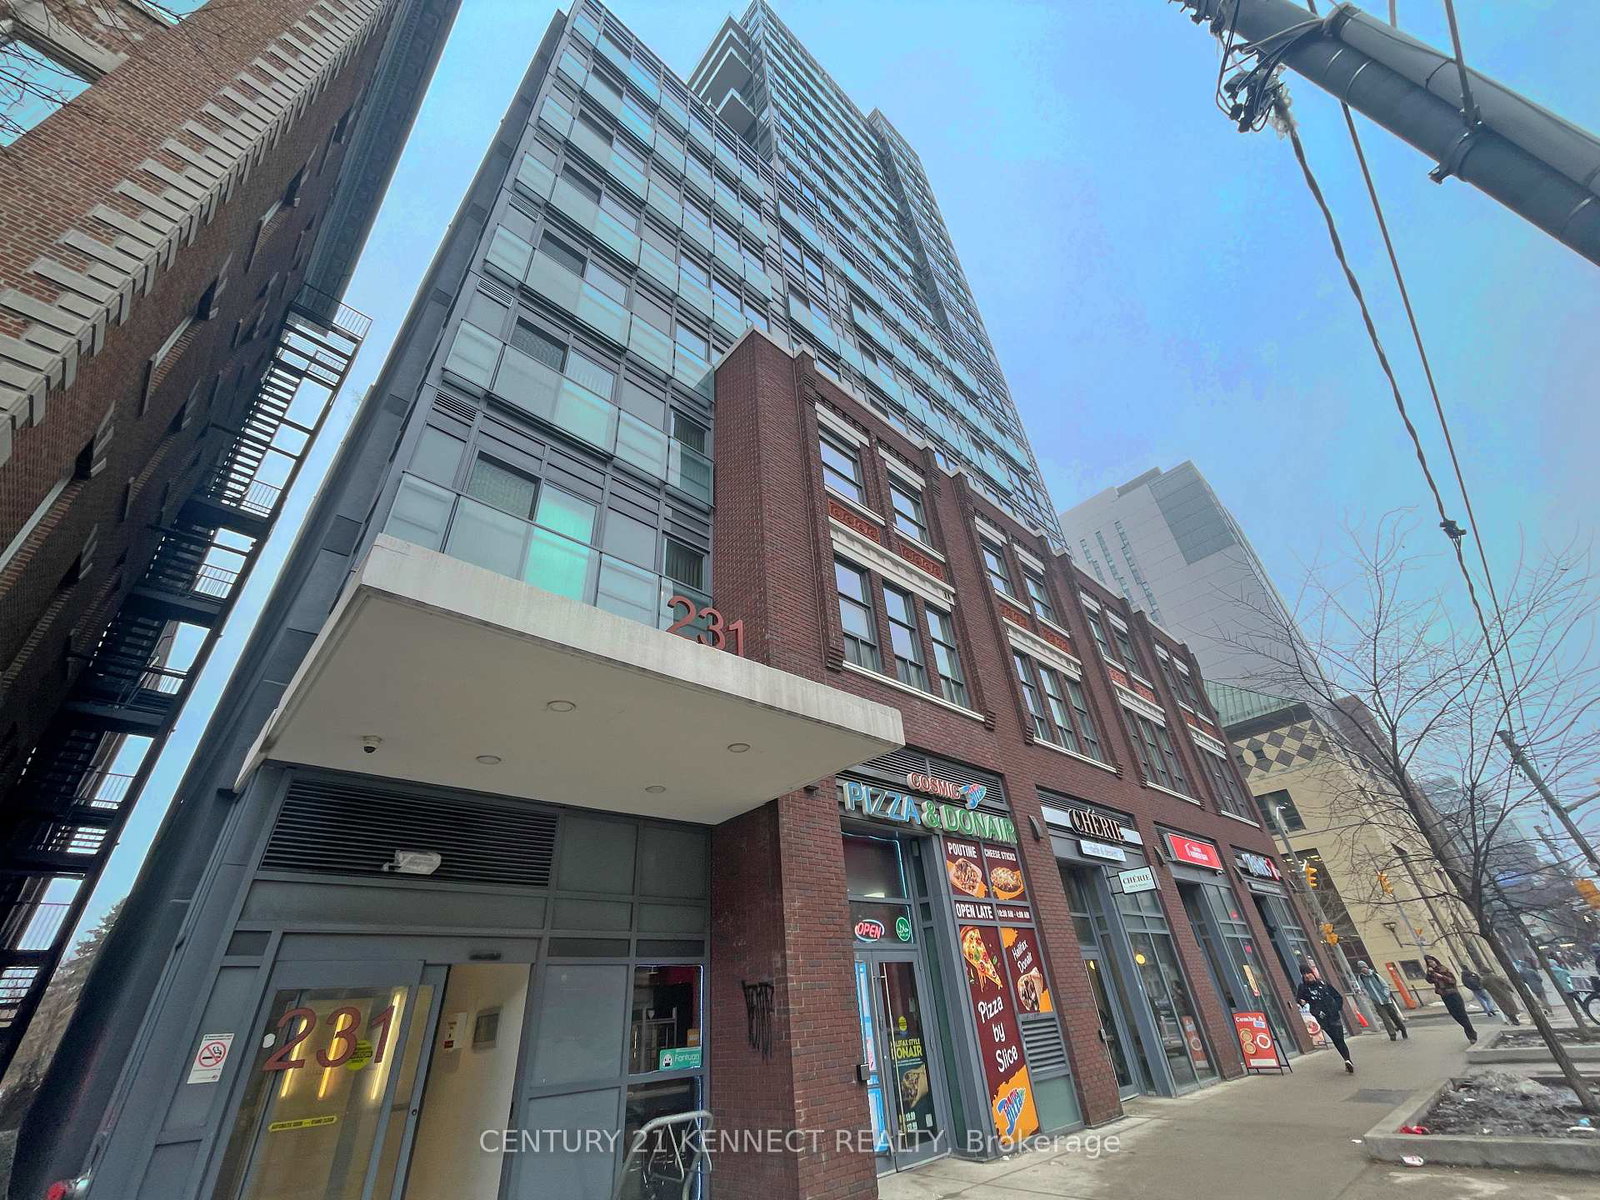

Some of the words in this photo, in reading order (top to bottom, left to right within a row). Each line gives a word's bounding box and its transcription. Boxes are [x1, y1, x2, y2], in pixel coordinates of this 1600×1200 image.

[666, 595, 744, 656] 231
[906, 772, 961, 800] COSMIC
[843, 782, 921, 824] PIZZA
[921, 800, 942, 829] &
[939, 804, 1018, 844] DONAIR
[947, 842, 977, 859] POUTINE
[955, 903, 975, 918] OPEN
[976, 905, 993, 919] LATE
[857, 922, 881, 939] OPEN
[1012, 939, 1028, 960] Halifax
[1017, 951, 1032, 973] Donair
[978, 996, 1003, 1023] Pizza
[261, 1006, 395, 1072] 231
[992, 1022, 1005, 1042] by
[995, 1045, 1018, 1073] Slice
